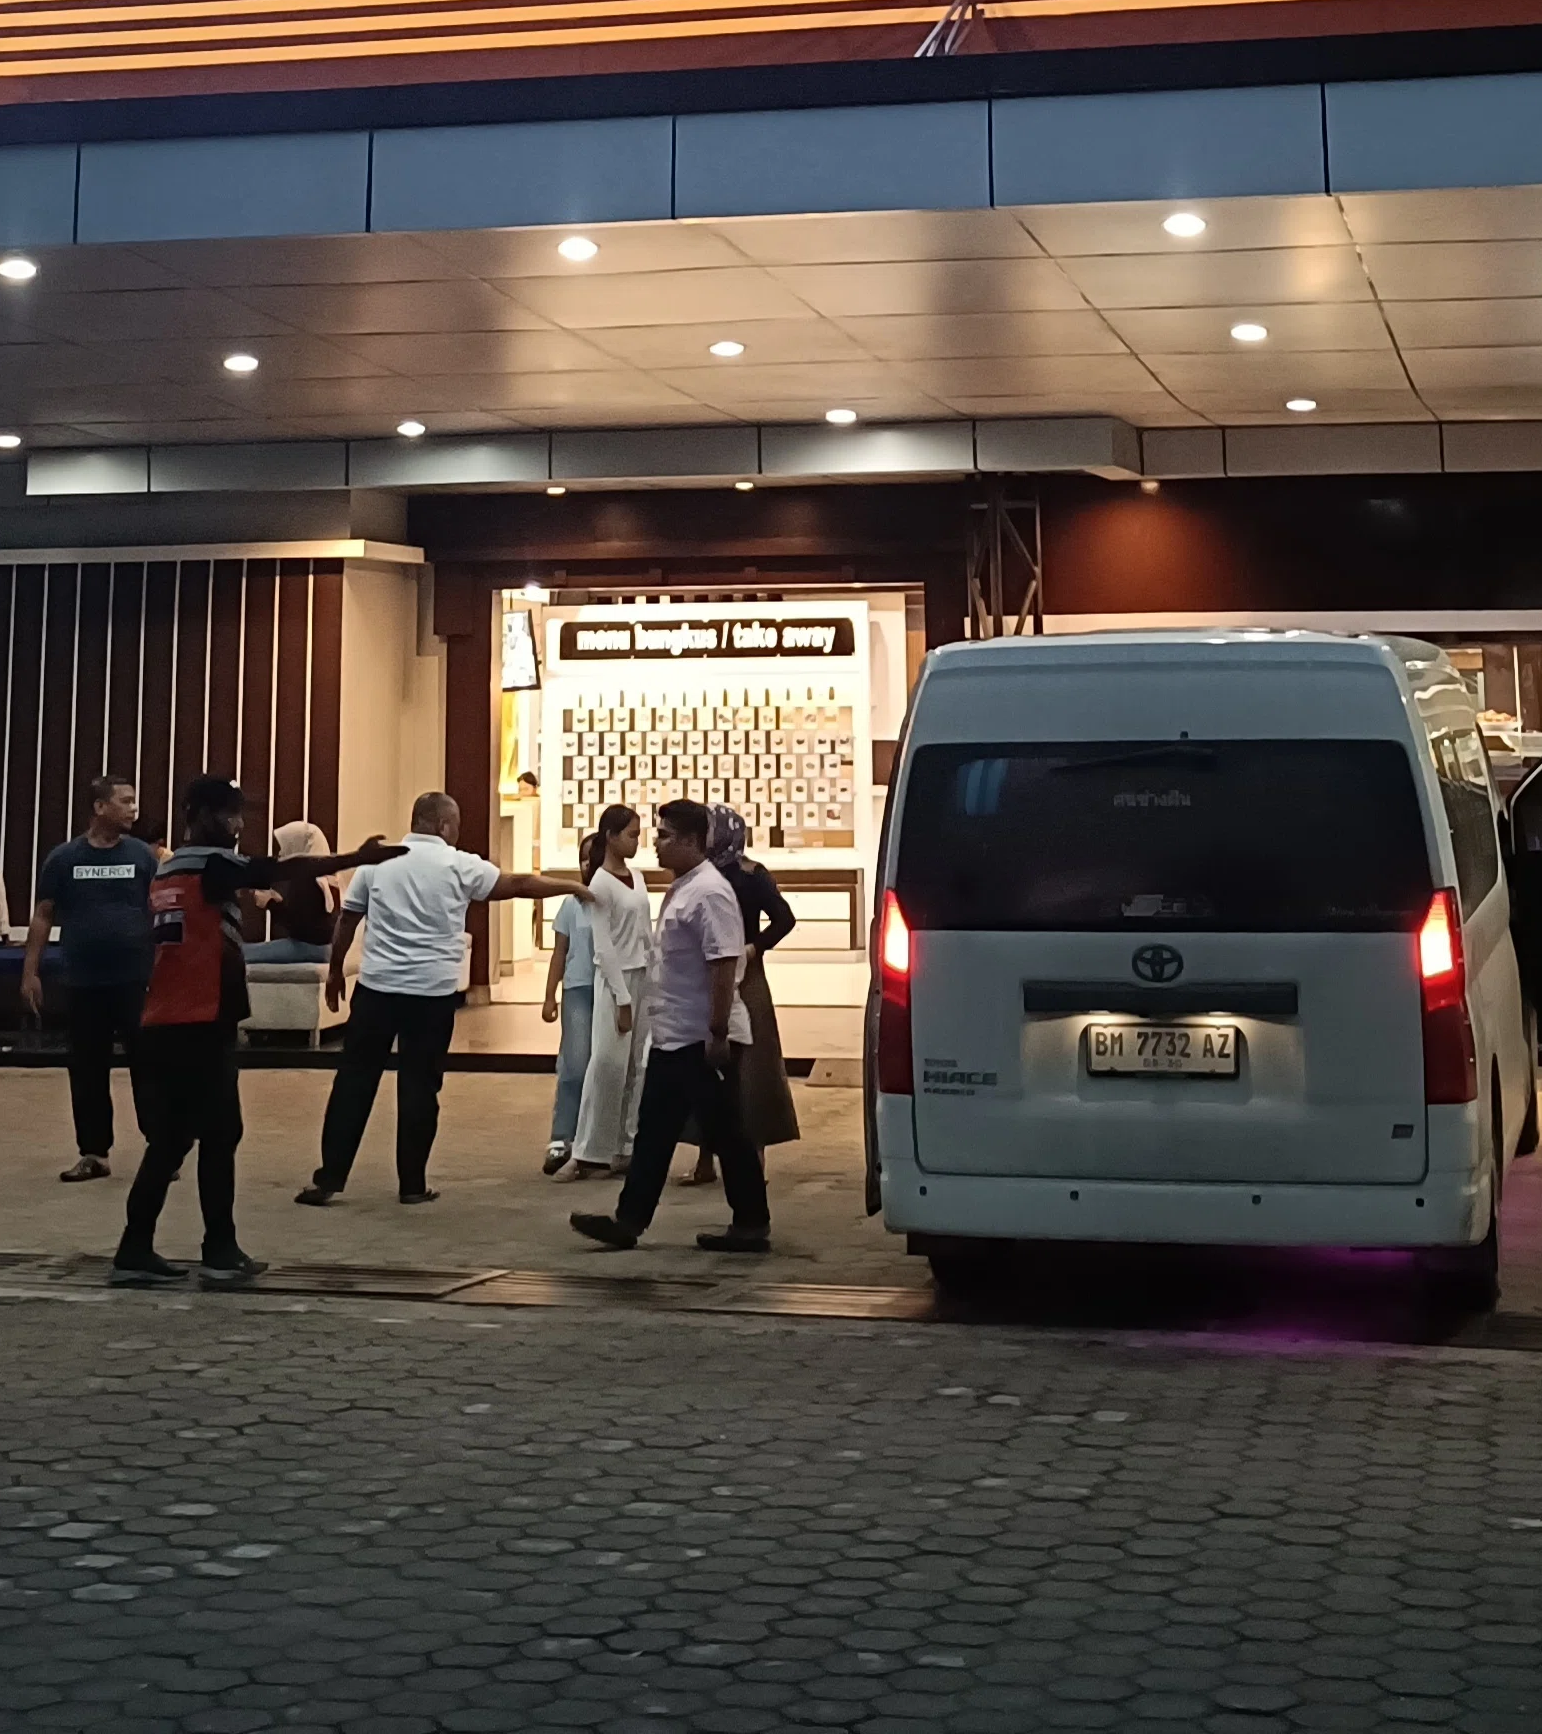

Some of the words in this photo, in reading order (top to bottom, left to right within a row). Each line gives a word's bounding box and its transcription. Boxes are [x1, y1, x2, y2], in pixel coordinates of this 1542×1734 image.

[577, 630, 630, 650] menu
[634, 622, 717, 655] bungkus
[732, 621, 778, 649] take
[781, 626, 836, 653] away
[75, 867, 132, 878] SYNERGY
[1095, 1032, 1123, 1056] BM
[1137, 1032, 1191, 1058] 7732
[1203, 1033, 1230, 1058] AZ
[924, 1071, 997, 1086] HIACE
